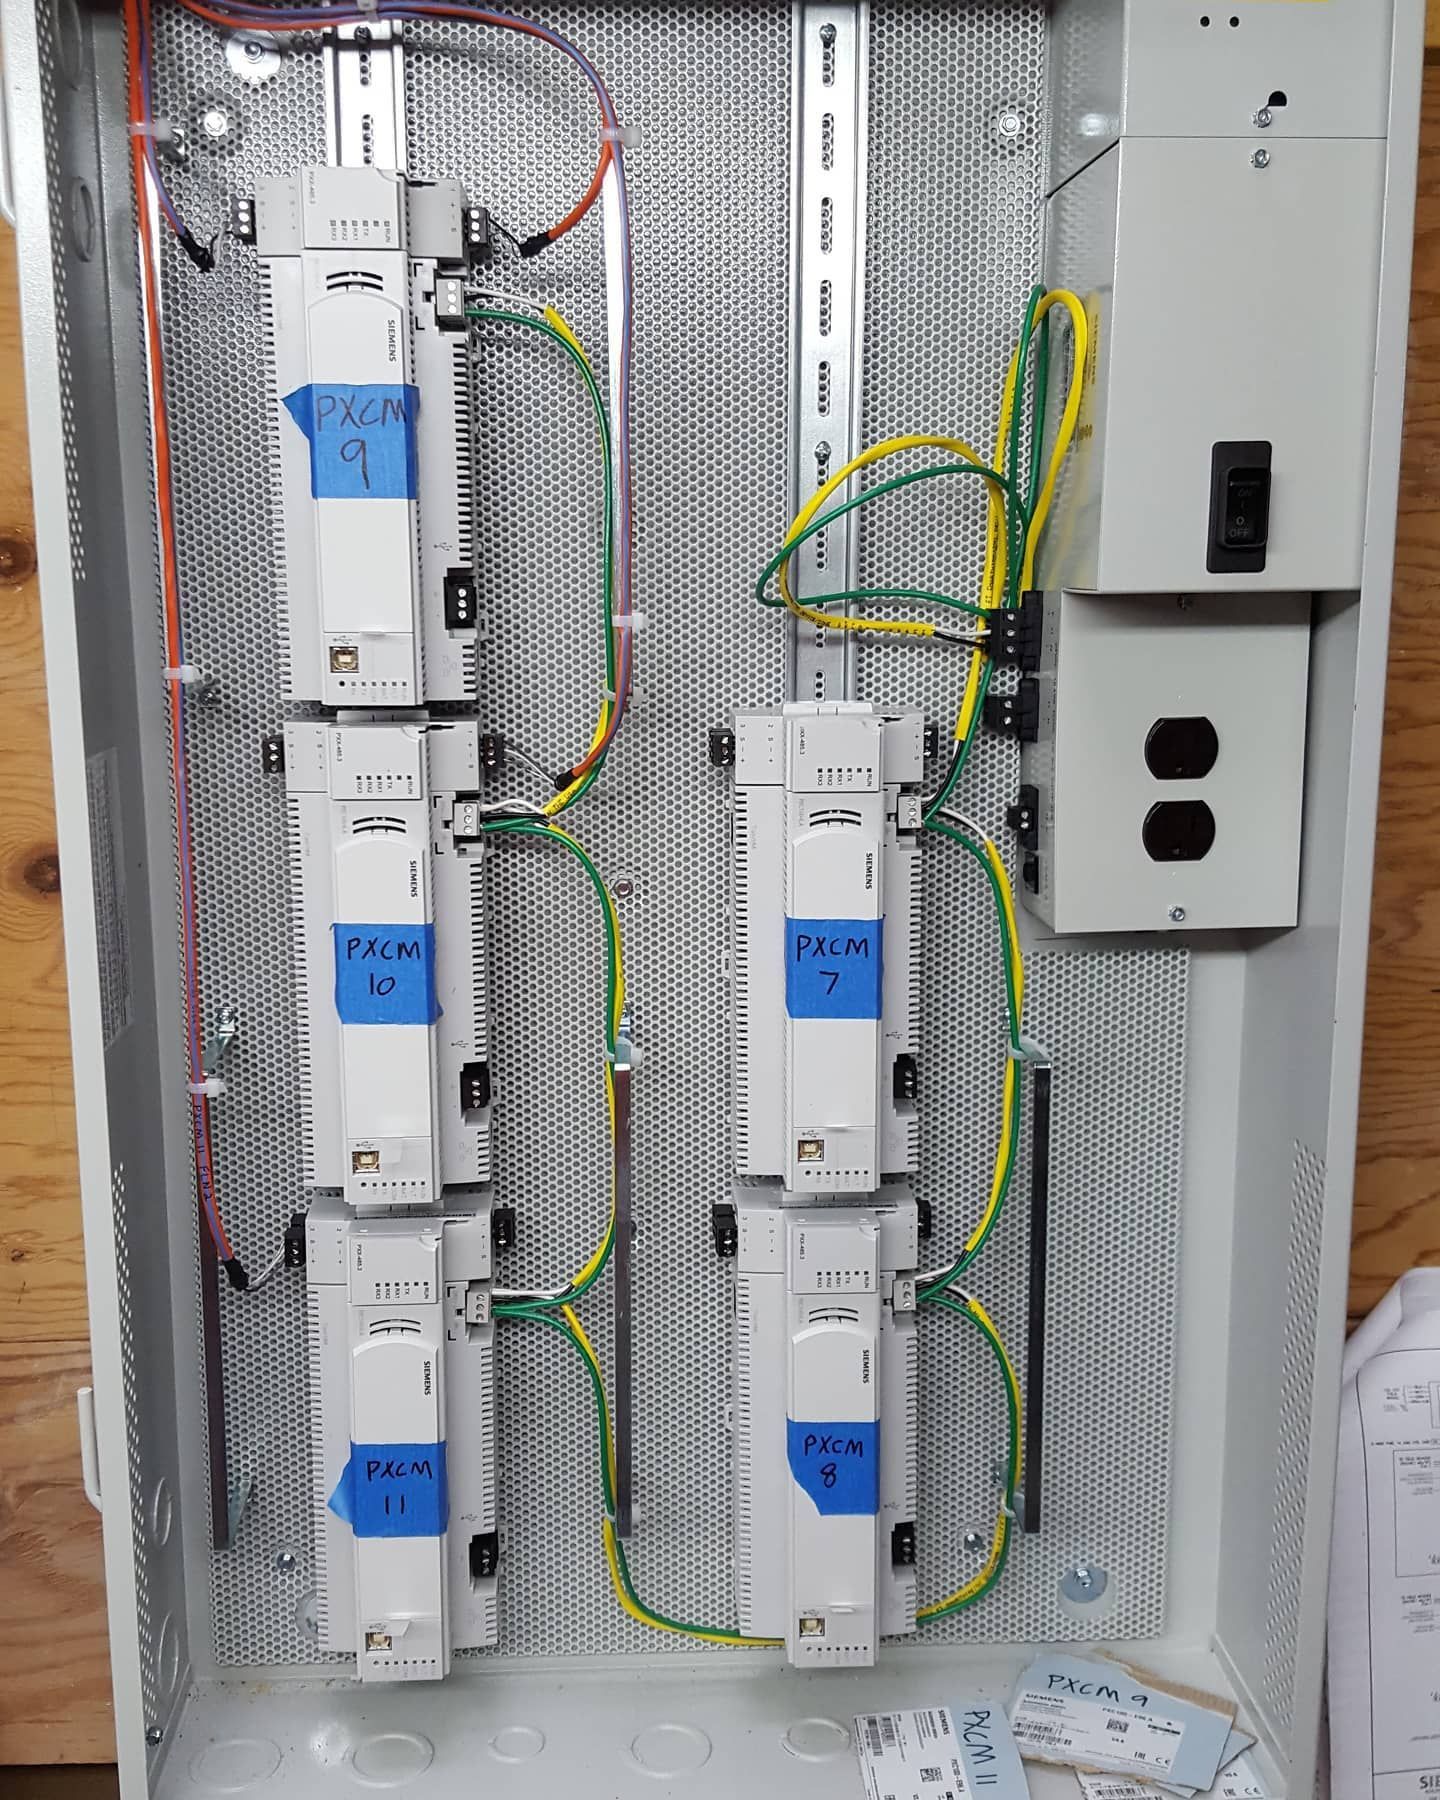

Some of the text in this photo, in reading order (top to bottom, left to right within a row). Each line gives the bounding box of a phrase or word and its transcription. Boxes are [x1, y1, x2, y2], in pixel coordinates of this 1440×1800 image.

[387, 319, 397, 363] SIEMENS
[316, 393, 408, 432] PXCM
[339, 438, 371, 490] 9
[1228, 528, 1249, 538] OFF
[409, 859, 418, 898] SIEMENS
[864, 852, 873, 890] SIEMENS
[346, 937, 421, 960] PXCM
[796, 934, 869, 962] PXCM
[369, 973, 397, 996] 10
[818, 970, 840, 995] 7
[193, 1104, 204, 1140] PXCM
[423, 1360, 431, 1396] SIEMENS
[862, 1349, 870, 1384] SIEMENS
[803, 1435, 863, 1457] PXCM
[366, 1460, 433, 1481] PXCM
[819, 1462, 837, 1488] 8
[384, 1495, 405, 1515] 11
[1047, 1674, 1149, 1707] PXCM 9
[938, 1709, 950, 1735] SIEMENS
[962, 1710, 998, 1785] PXCM 11
